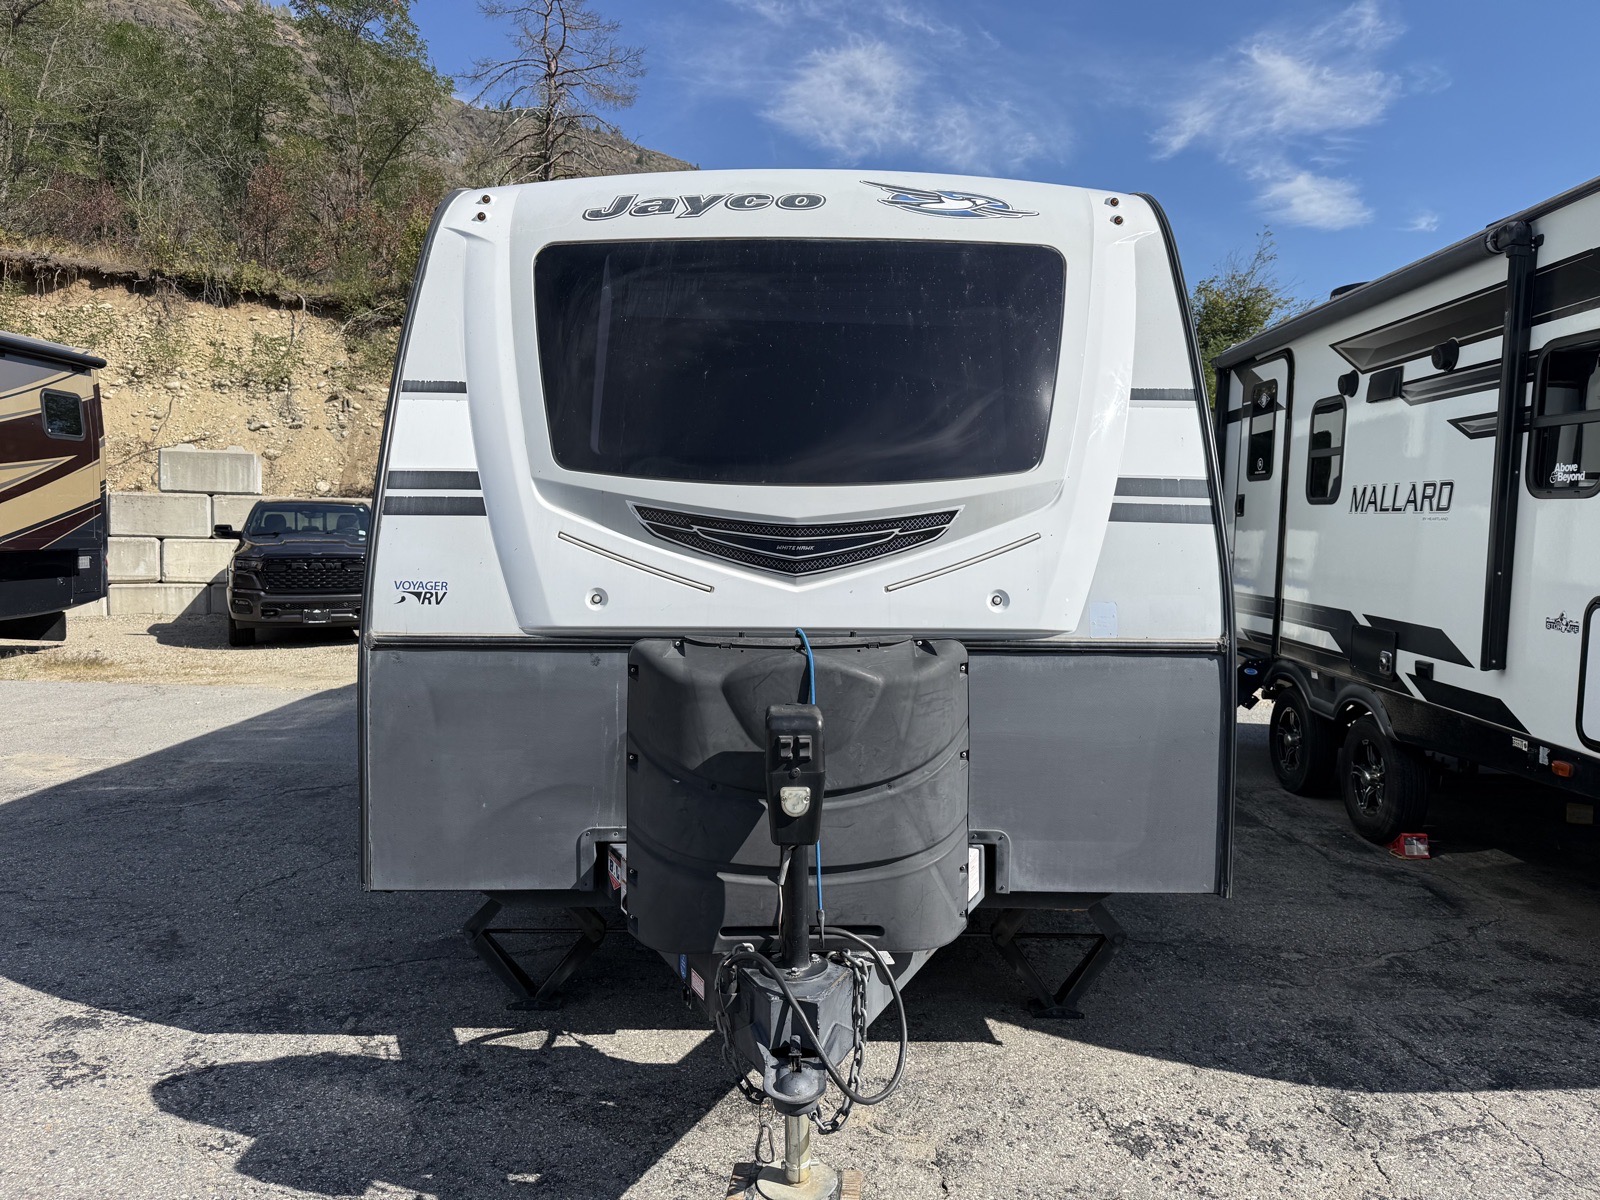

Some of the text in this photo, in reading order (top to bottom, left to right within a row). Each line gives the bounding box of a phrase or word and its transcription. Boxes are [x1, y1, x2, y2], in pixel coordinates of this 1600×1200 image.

[582, 193, 826, 221] Jayco
[1555, 462, 1578, 472] Above
[1557, 471, 1586, 483] Beyond
[1348, 479, 1455, 514] MALLARD
[291, 562, 342, 570] RAM
[394, 580, 448, 591] VOYAGER
[421, 591, 448, 605] RV
